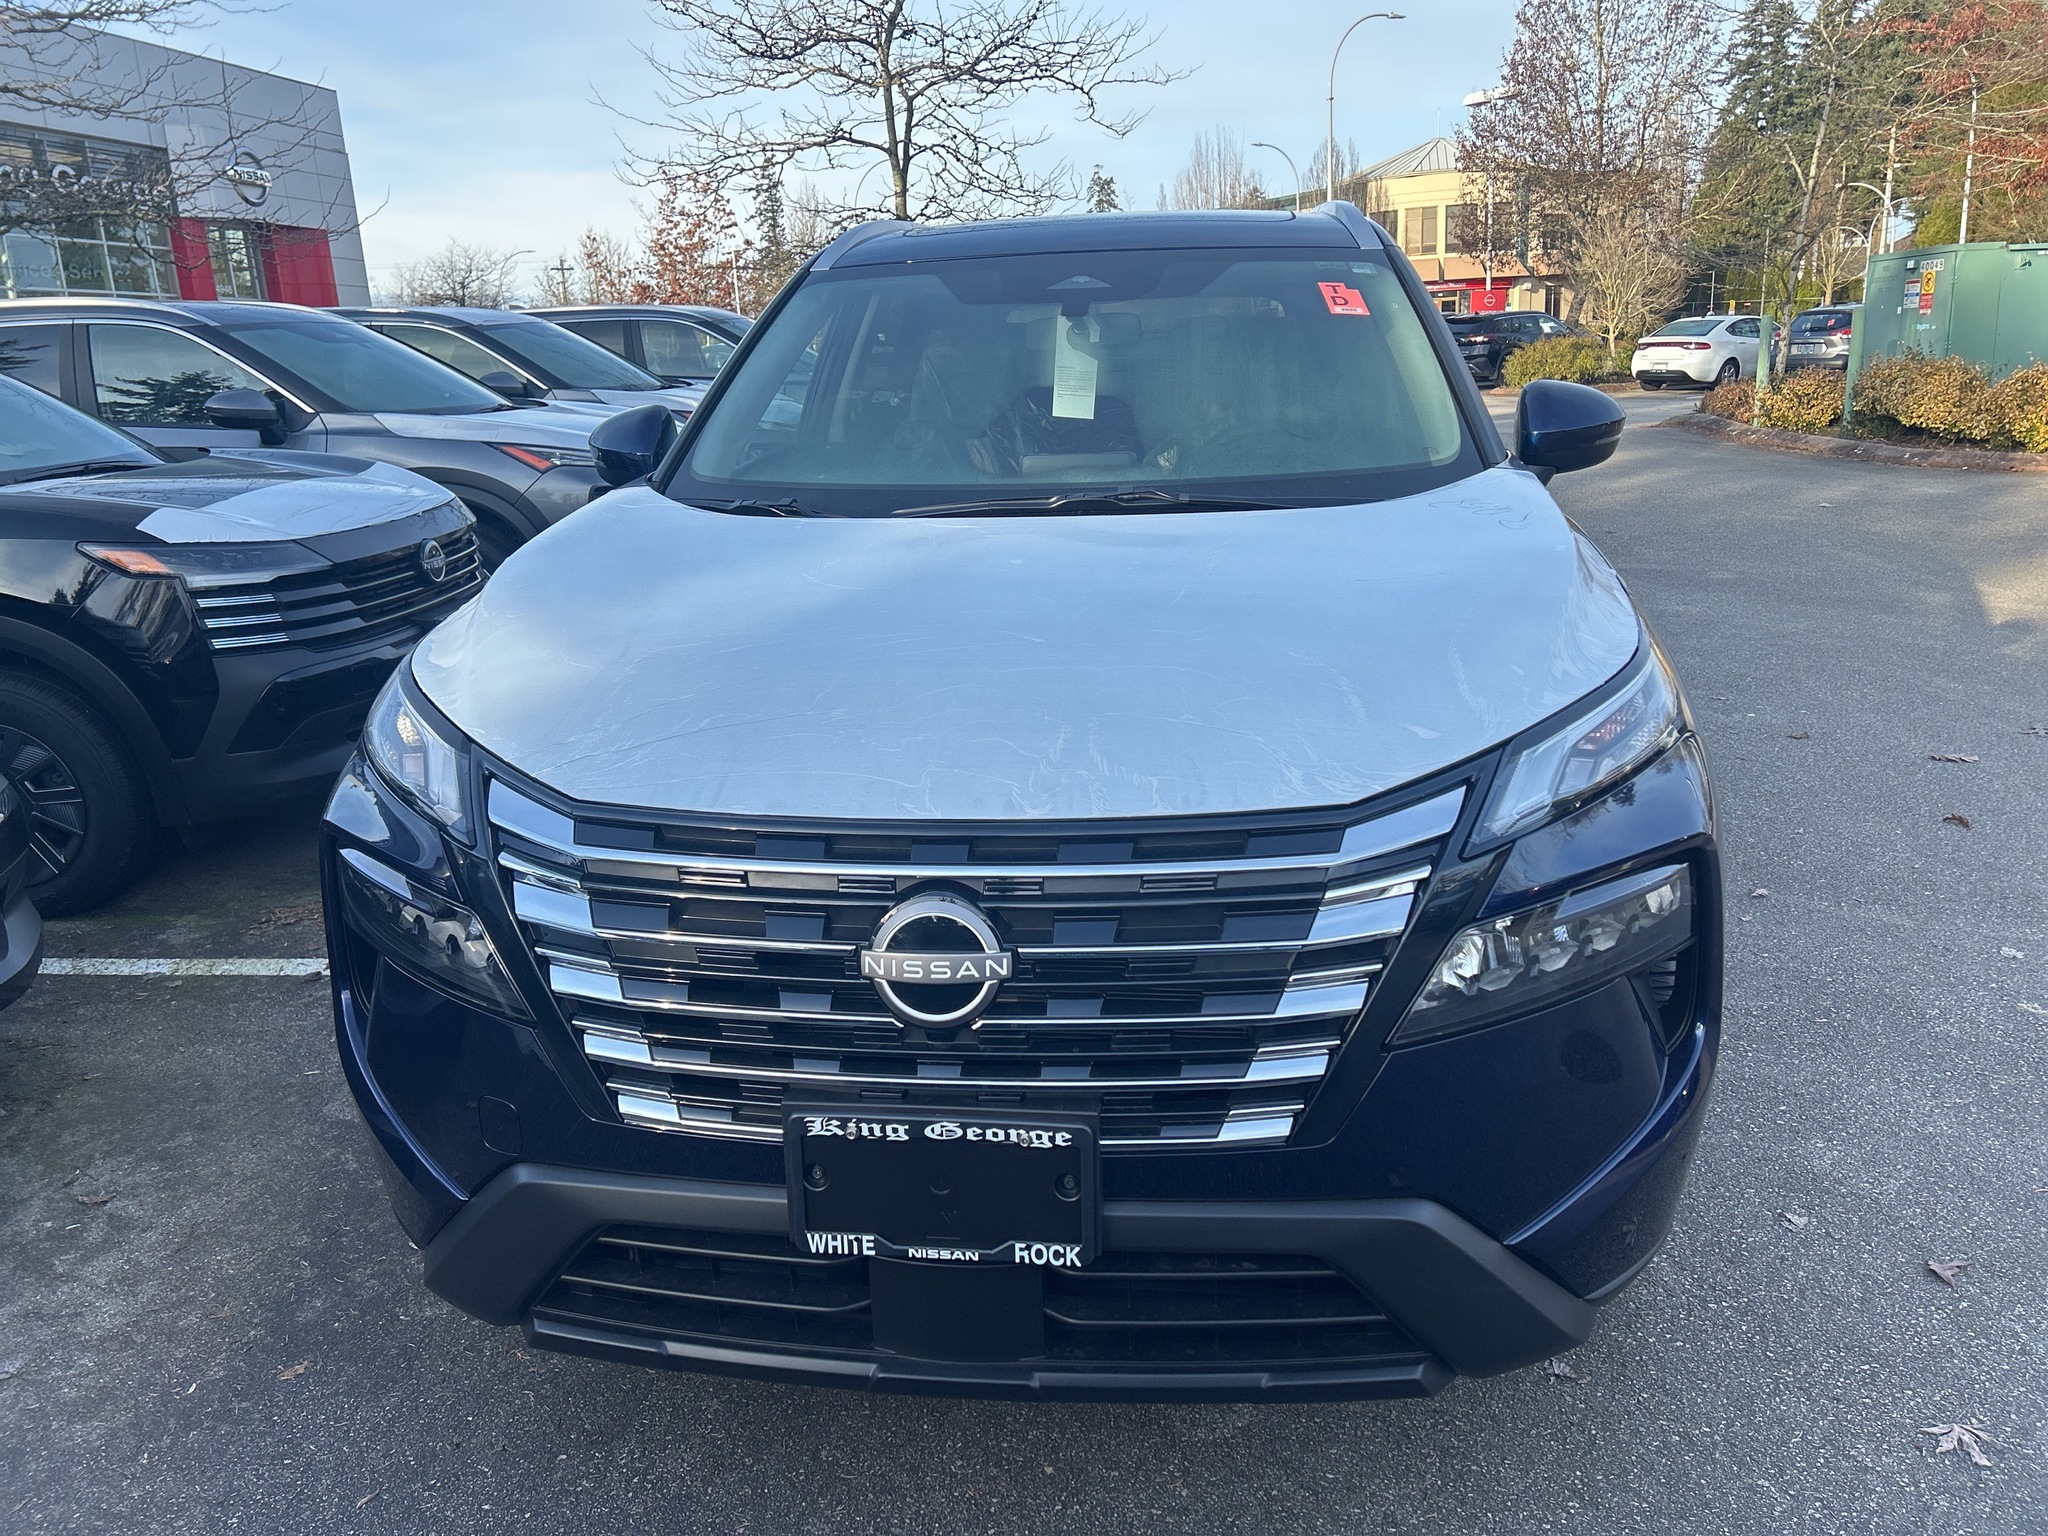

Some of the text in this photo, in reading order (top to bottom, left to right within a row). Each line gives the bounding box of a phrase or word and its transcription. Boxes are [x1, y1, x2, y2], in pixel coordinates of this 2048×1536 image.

[1920, 260, 1944, 271] 40049
[1325, 284, 1341, 294] T
[1330, 296, 1349, 306] D
[864, 956, 1008, 979] NISSAN
[924, 1121, 1073, 1148] George
[806, 1233, 1082, 1267] WHITE NISSAN ROCK
